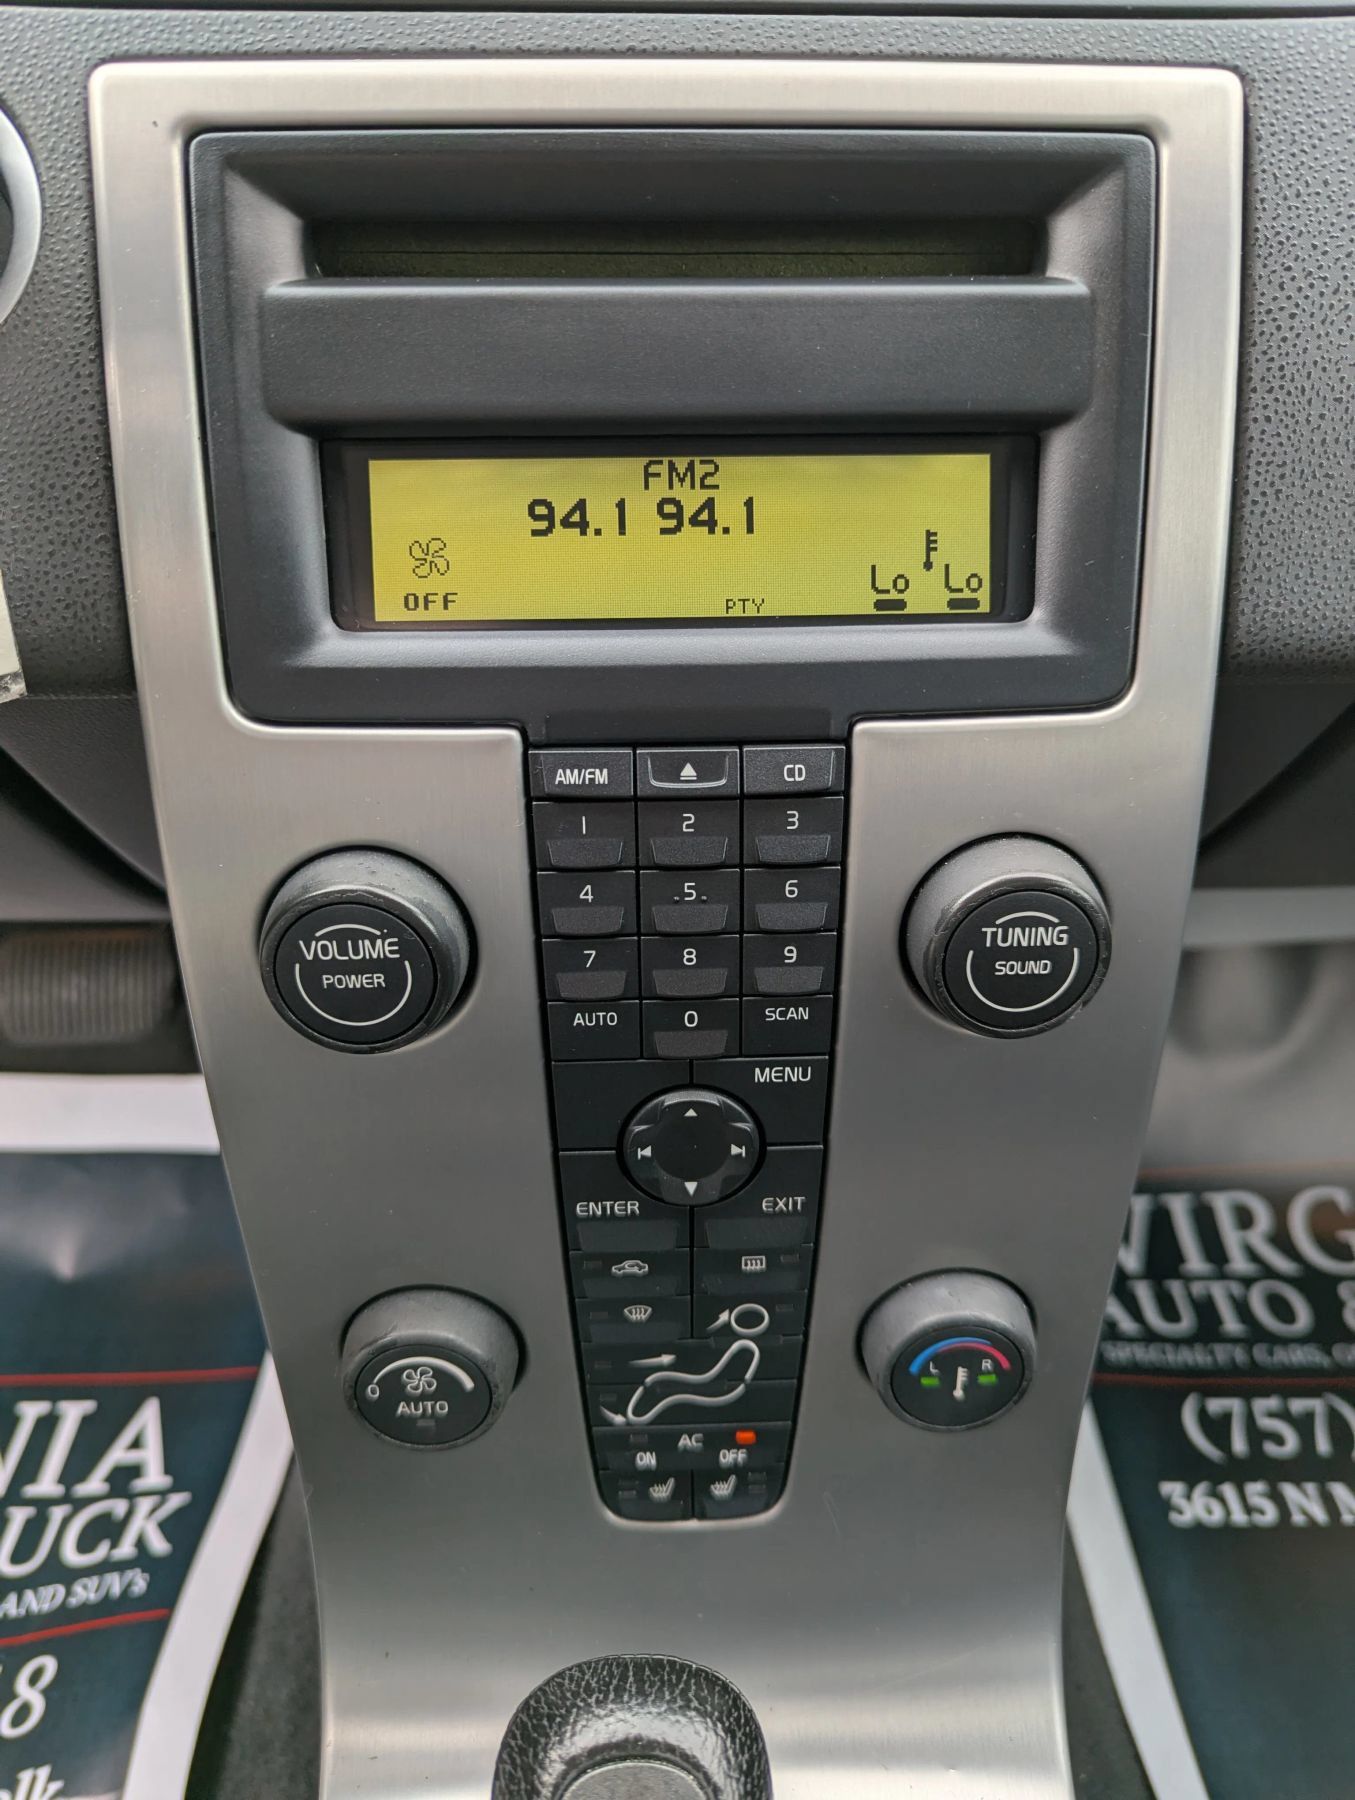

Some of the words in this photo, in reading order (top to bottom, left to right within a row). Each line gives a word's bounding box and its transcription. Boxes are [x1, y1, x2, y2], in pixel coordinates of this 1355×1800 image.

[643, 459, 720, 491] FM2
[527, 498, 627, 537] 94.1
[656, 496, 755, 535] 94.1
[871, 564, 909, 595] Lo
[944, 563, 983, 594] Lo
[403, 592, 459, 612] OFF
[725, 598, 766, 616] PTY
[555, 768, 608, 785] AM/FM
[783, 764, 806, 782] CD
[682, 813, 696, 832] 2
[786, 810, 800, 830] 3
[579, 884, 594, 903] 4
[683, 882, 697, 901] 5
[784, 879, 799, 898] 6
[981, 925, 1069, 948] TUNING
[299, 937, 401, 961] VOLUME
[682, 948, 697, 966] 8
[783, 946, 797, 963] 9
[583, 950, 597, 968] 7
[994, 959, 1053, 976] SOUND
[322, 973, 386, 989] POWER
[573, 1011, 618, 1027] AUTO
[684, 1010, 698, 1027] 0
[764, 1006, 809, 1021] SCAN
[754, 1066, 812, 1084] MENU
[576, 1201, 640, 1217] ENTER
[762, 1196, 806, 1213] EXIT
[929, 1360, 940, 1375] L
[981, 1358, 993, 1373] R
[396, 1400, 450, 1417] AUTO
[677, 1433, 704, 1449] AC
[635, 1451, 657, 1471] ON
[719, 1449, 748, 1469] OFF
[1158, 1480, 1279, 1528] 3615
